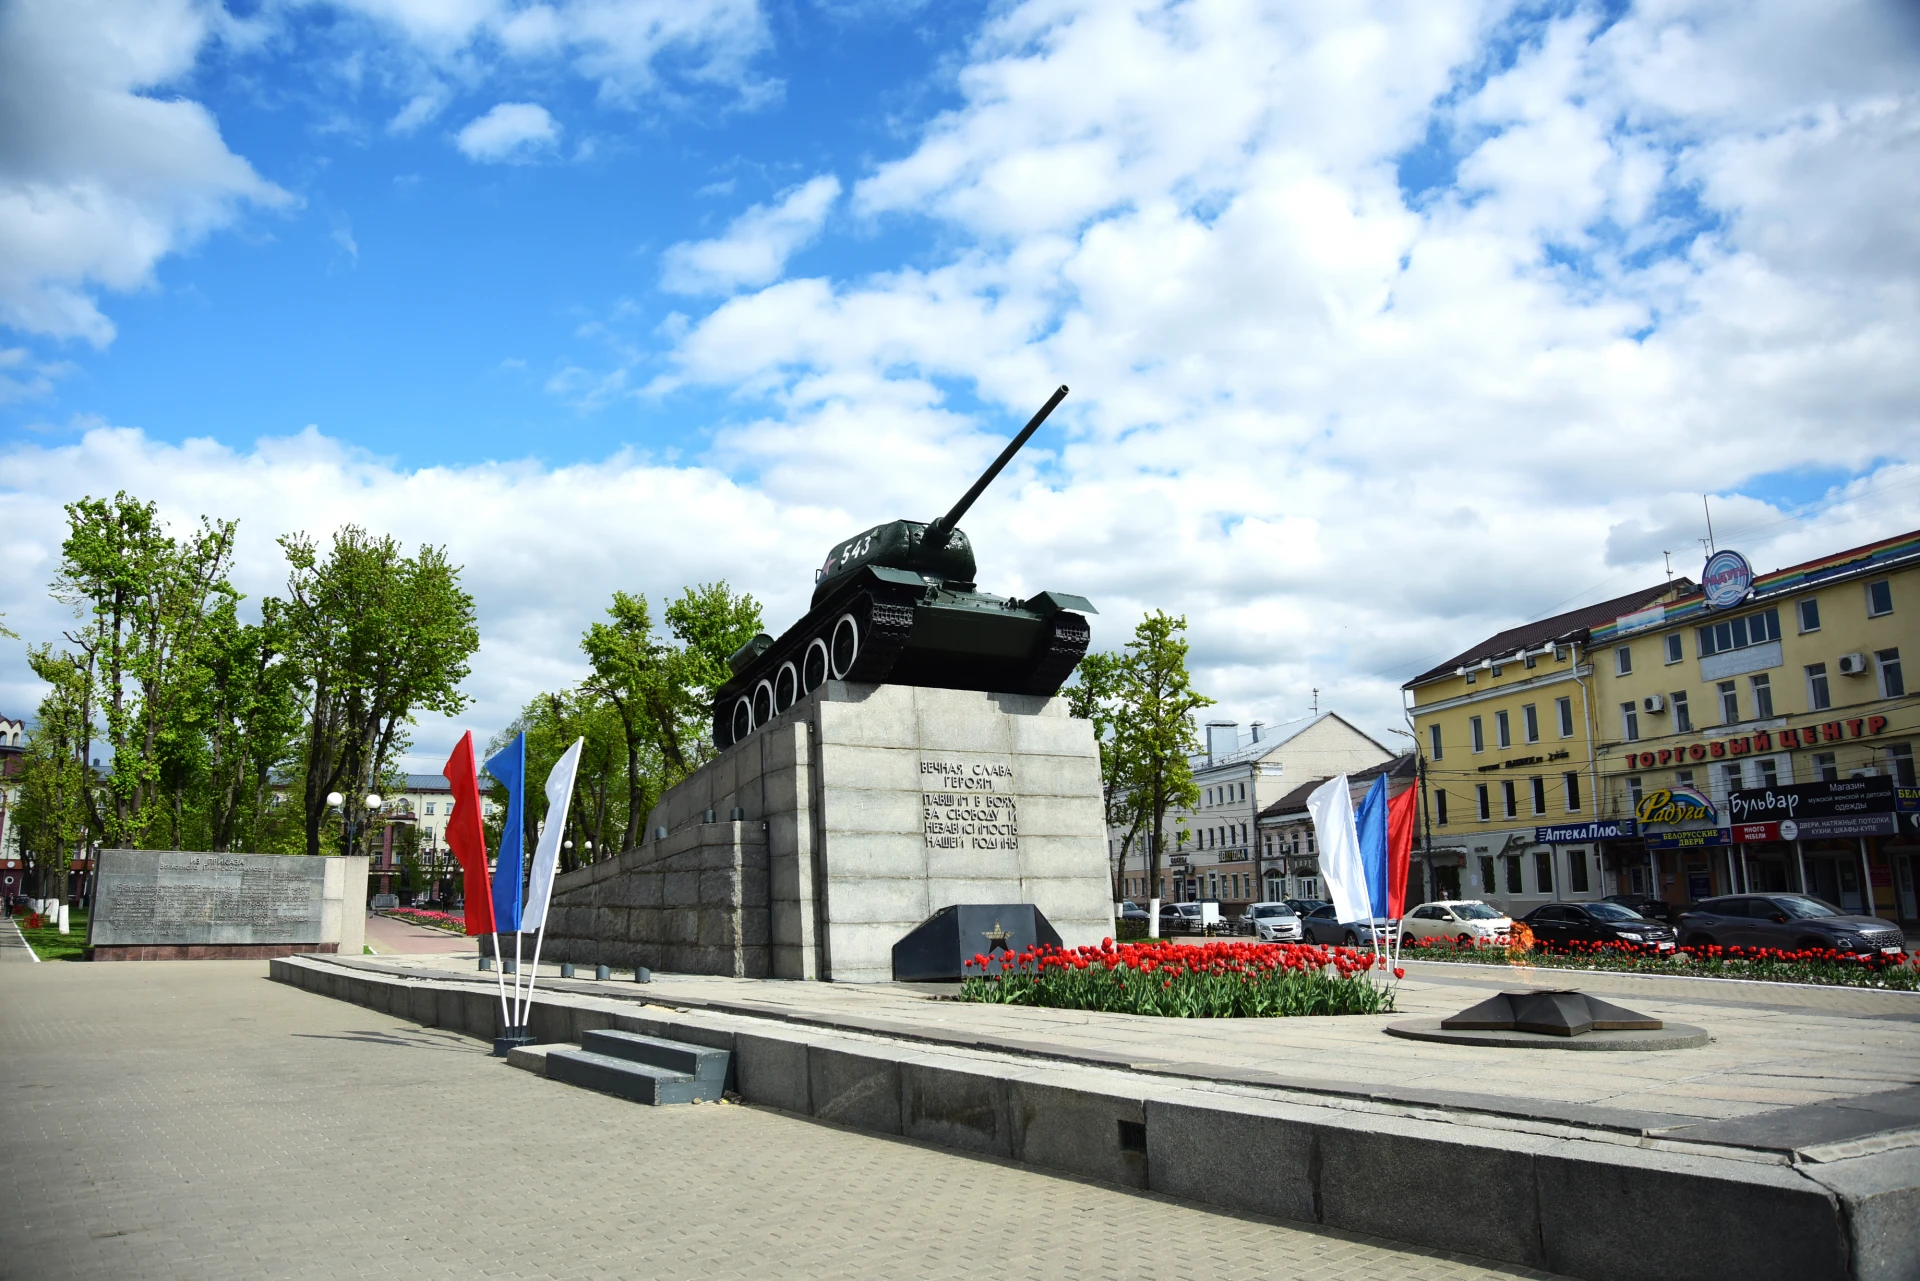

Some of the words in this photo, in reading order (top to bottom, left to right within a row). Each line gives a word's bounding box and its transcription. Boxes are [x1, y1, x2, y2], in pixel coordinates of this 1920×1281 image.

[841, 535, 872, 565] 543
[1703, 566, 1748, 588] РАДУГА
[1625, 730, 1772, 769] ТОРГОВЫЙ
[1779, 715, 1888, 750] ЦЕНТР
[920, 761, 963, 775] ВЕЧНАЯ
[972, 764, 1013, 777] СЛАВА
[944, 776, 995, 793] ГЕРОЯМ,
[1829, 782, 1866, 793] Магазин
[923, 793, 969, 807] ПАВШИМ
[974, 795, 981, 808] В
[986, 795, 1017, 809] БОЯХ
[1808, 795, 1833, 804] мужской
[1833, 793, 1859, 802] женской
[1865, 790, 1892, 799] детской
[1635, 789, 1708, 825] Радуга
[1729, 791, 1799, 821] Бульвар
[1834, 802, 1867, 812] одежды
[924, 808, 940, 820] ЗА
[946, 808, 999, 822] СВОБОДУ
[1008, 810, 1017, 822] И
[924, 821, 1018, 836] НЕЗАВИСИМОСТЬ
[1743, 825, 1766, 834] МНОГО
[1822, 819, 1858, 827] НАТЯЖНЫЕ
[1833, 825, 1877, 834] ШКАФЫ-КУПЕ
[1662, 829, 1718, 841] БЕЛОРУССКИЕ
[1744, 832, 1767, 840] МЕБЕЛИ
[925, 836, 965, 849] НАШЕЙ
[972, 836, 1019, 850] РОДИНЫ
[1678, 838, 1705, 847] ДВЕРИ
[207, 857, 245, 867] ПРИКАЗА
